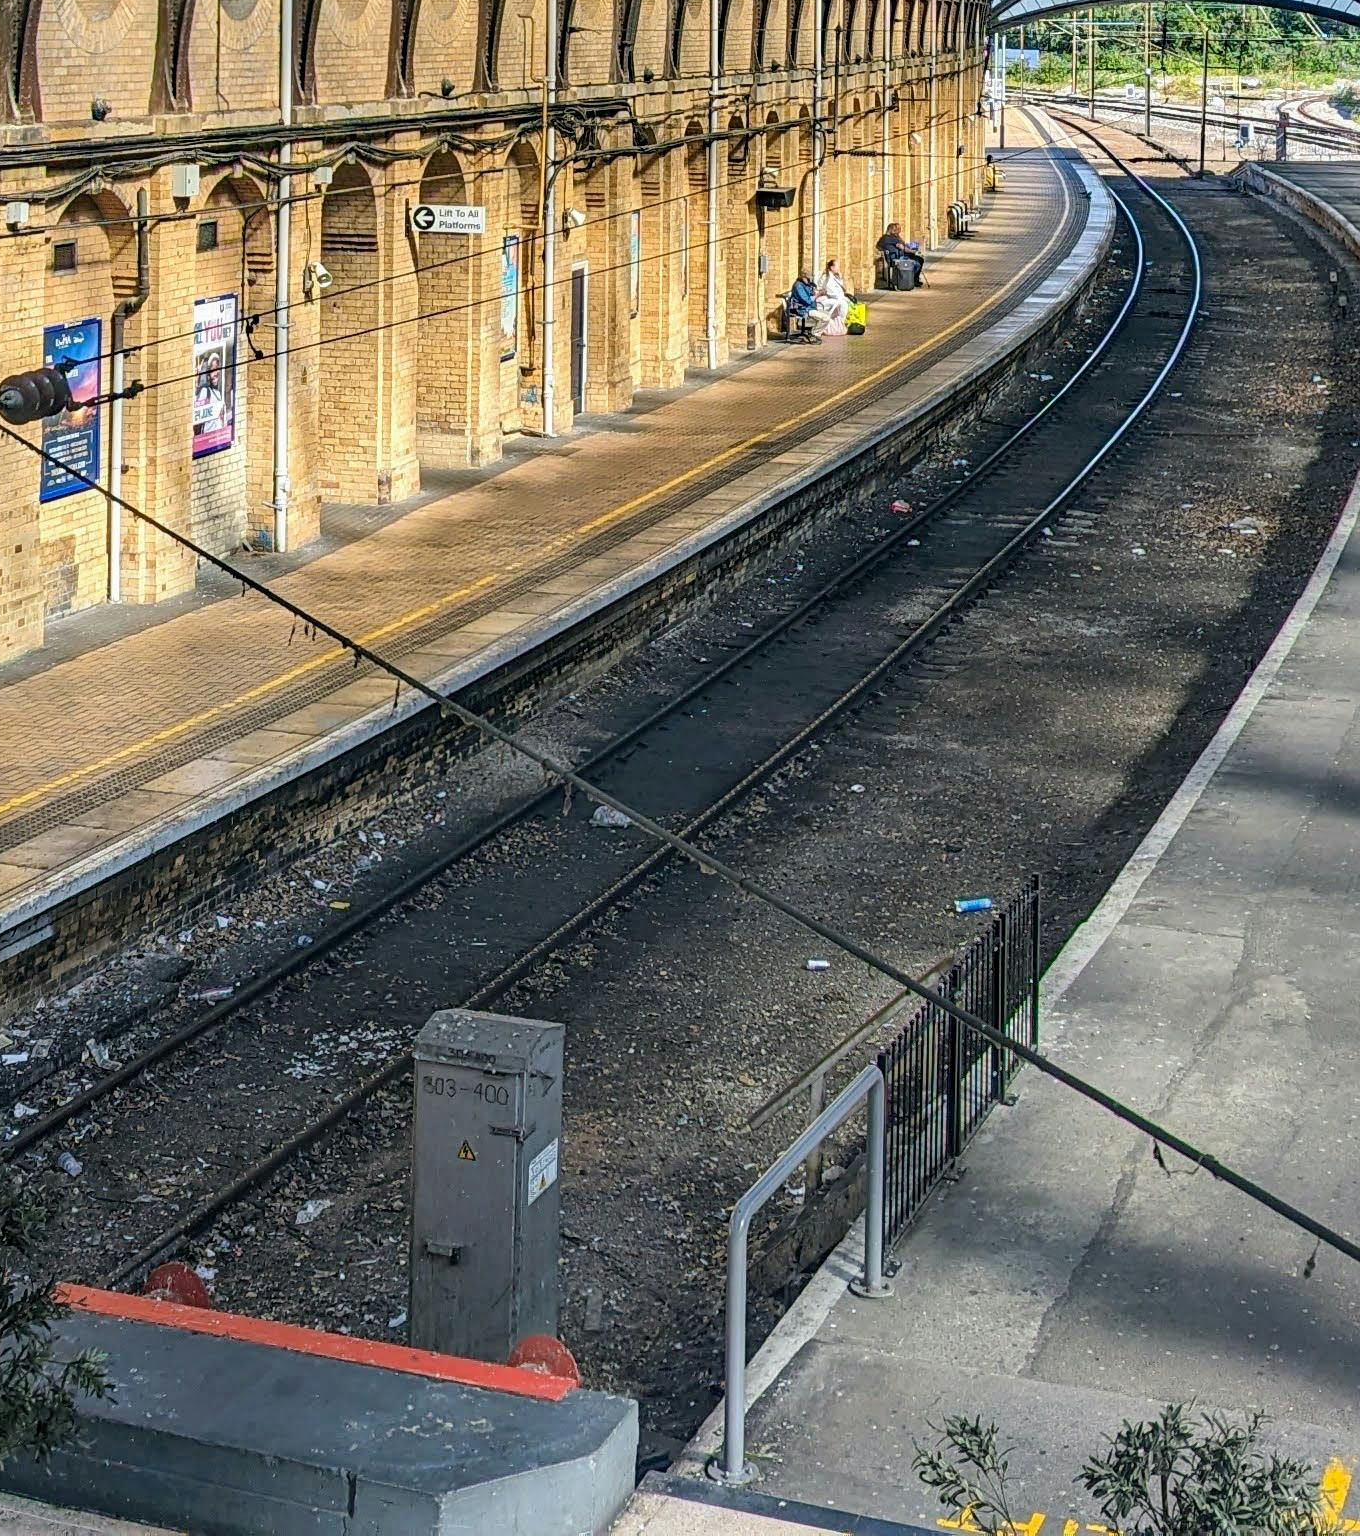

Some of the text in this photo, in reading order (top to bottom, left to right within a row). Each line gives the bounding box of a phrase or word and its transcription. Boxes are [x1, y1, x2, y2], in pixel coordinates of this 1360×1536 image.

[439, 209, 479, 218] Lift To All
[439, 220, 481, 230] Platforms
